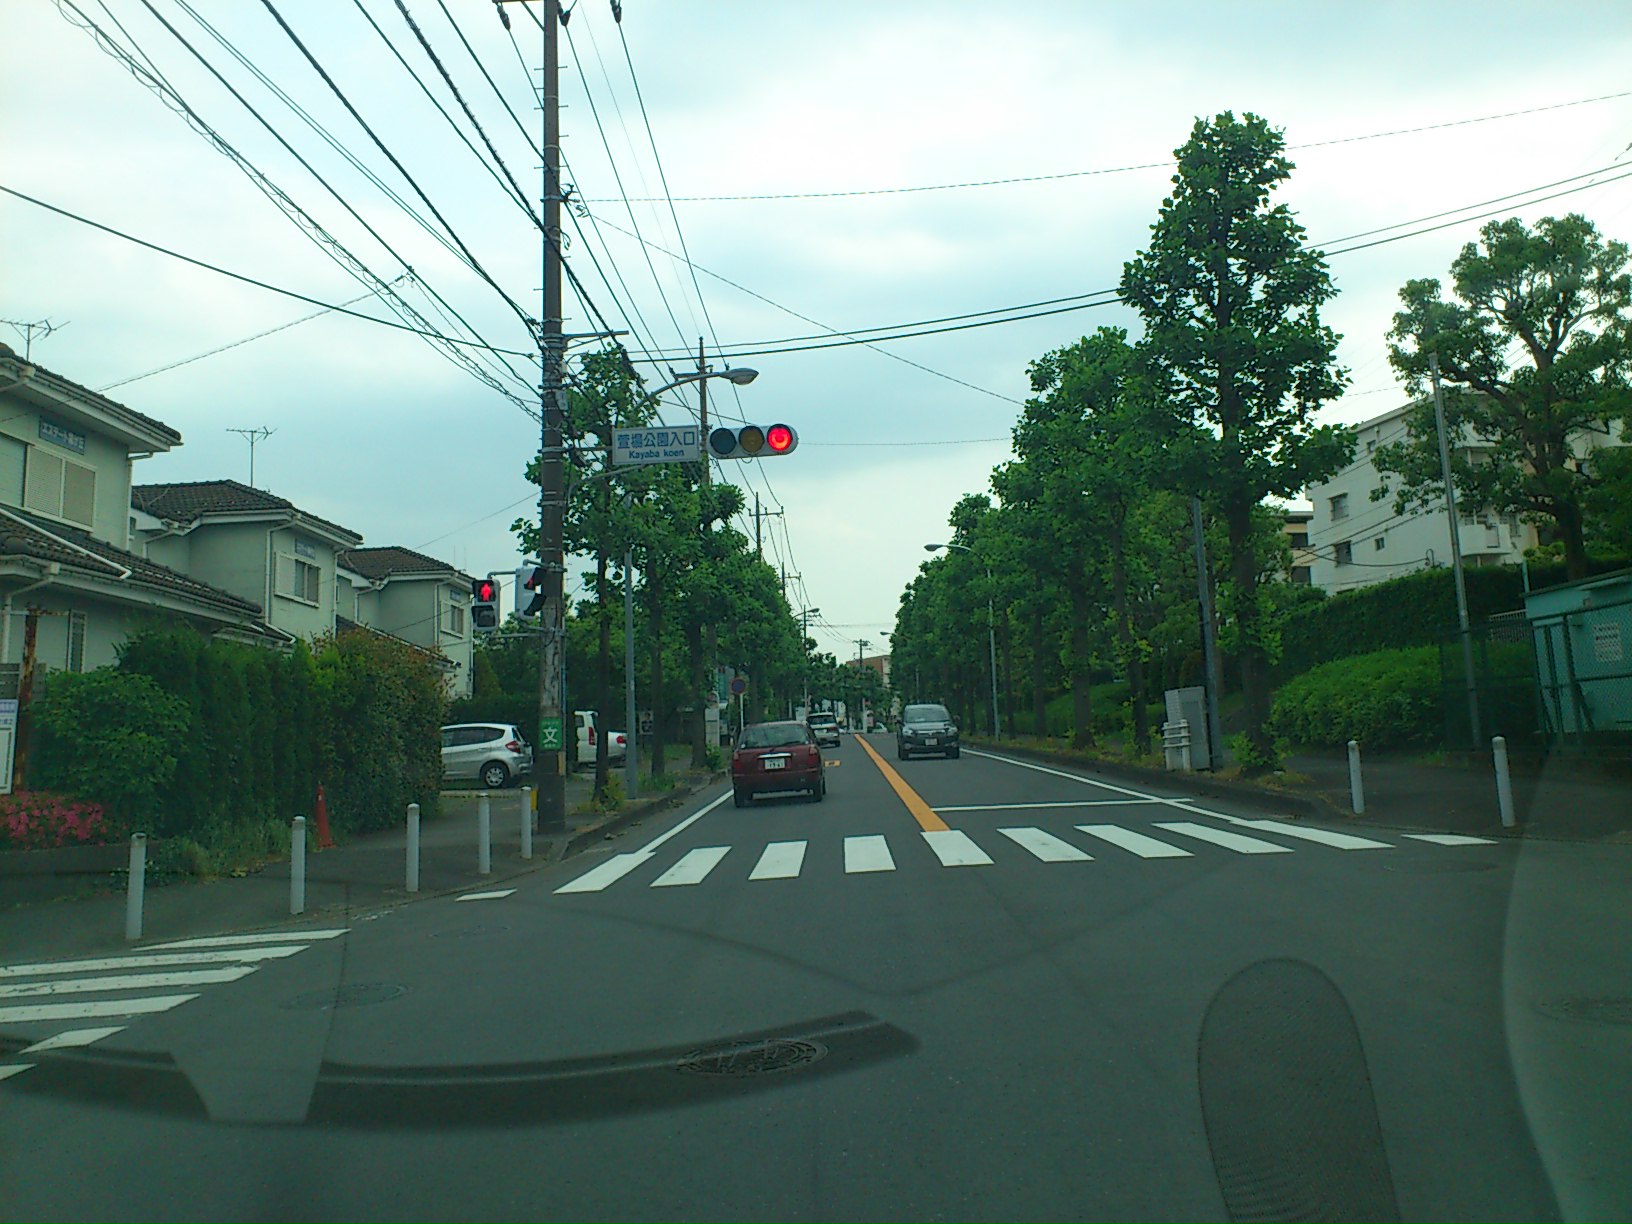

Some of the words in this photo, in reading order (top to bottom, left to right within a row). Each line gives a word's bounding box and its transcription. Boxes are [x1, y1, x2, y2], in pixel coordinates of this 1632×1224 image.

[617, 432, 695, 449] 萱場公園入口
[629, 450, 660, 459] Kayaba
[663, 449, 684, 457] koen
[543, 726, 558, 744] 文
